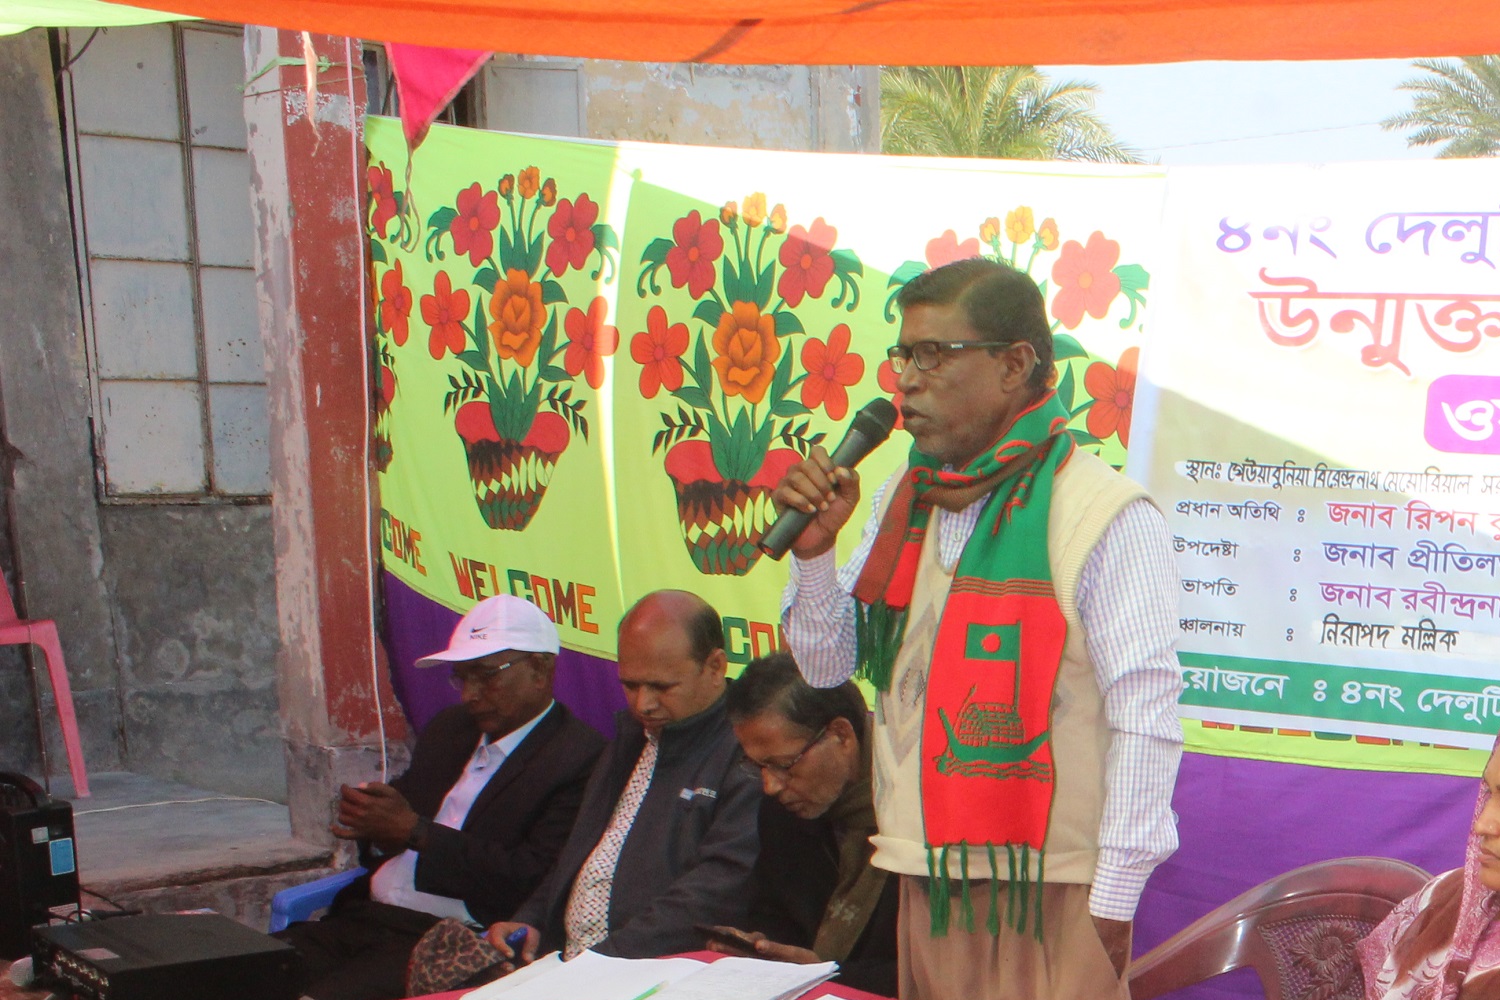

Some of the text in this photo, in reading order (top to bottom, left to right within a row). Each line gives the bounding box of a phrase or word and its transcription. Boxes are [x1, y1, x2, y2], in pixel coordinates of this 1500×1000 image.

[1216, 218, 1337, 259] ৪নং
[1383, 467, 1472, 494] মেমোরিয়াল
[1176, 501, 1222, 517] প্রধান
[1227, 501, 1281, 520] অতিথি
[1327, 502, 1397, 528] জনাব
[1404, 500, 1477, 535] রিপন
[1173, 535, 1239, 558] উপদেষ্টা
[1322, 543, 1399, 569] জনাব
[1182, 578, 1238, 596] ভাপতি
[1319, 583, 1396, 609] জনাব
[1321, 612, 1395, 648] নিরাপদ
[1402, 618, 1459, 651] মল্লিক
[1341, 681, 1404, 712] ৪নং
